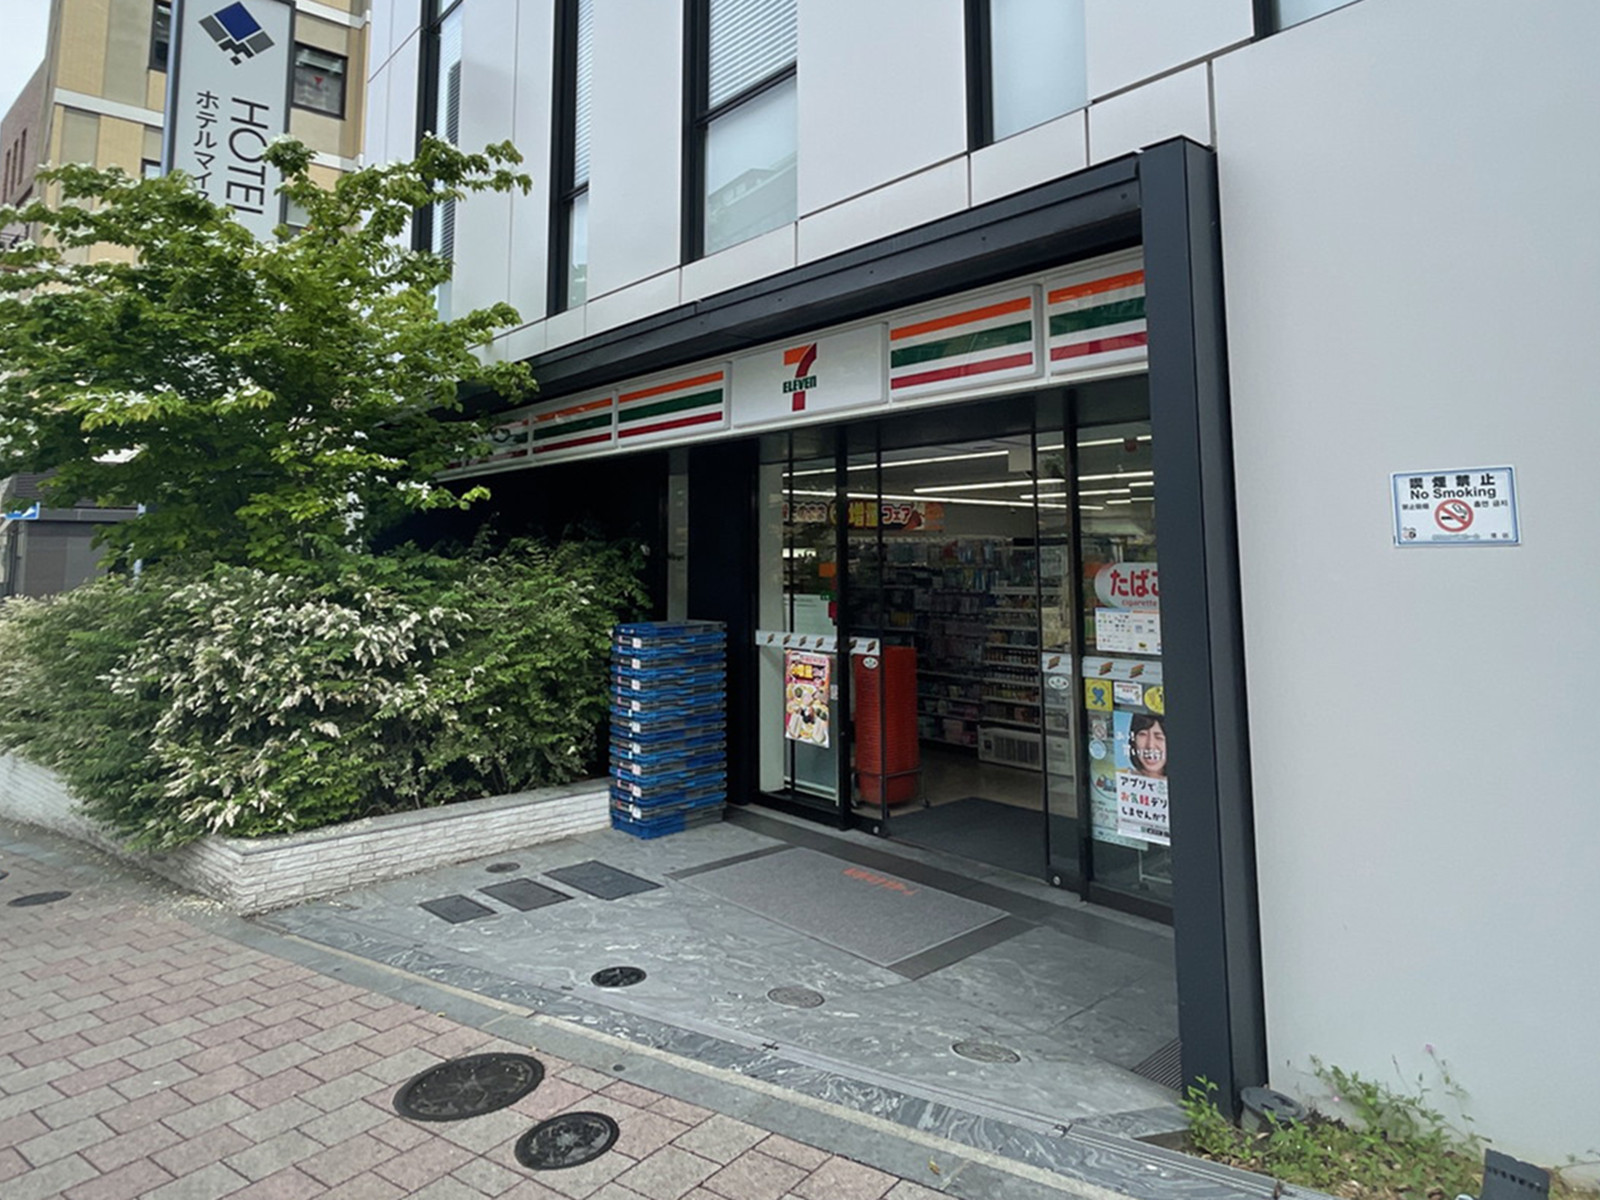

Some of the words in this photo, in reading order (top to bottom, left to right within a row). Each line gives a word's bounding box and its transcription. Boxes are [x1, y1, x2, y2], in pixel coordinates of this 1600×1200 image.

[225, 96, 270, 215] HOTEL
[783, 342, 818, 412] 7
[1410, 489, 1430, 500] No
[1433, 487, 1497, 499] Smoking
